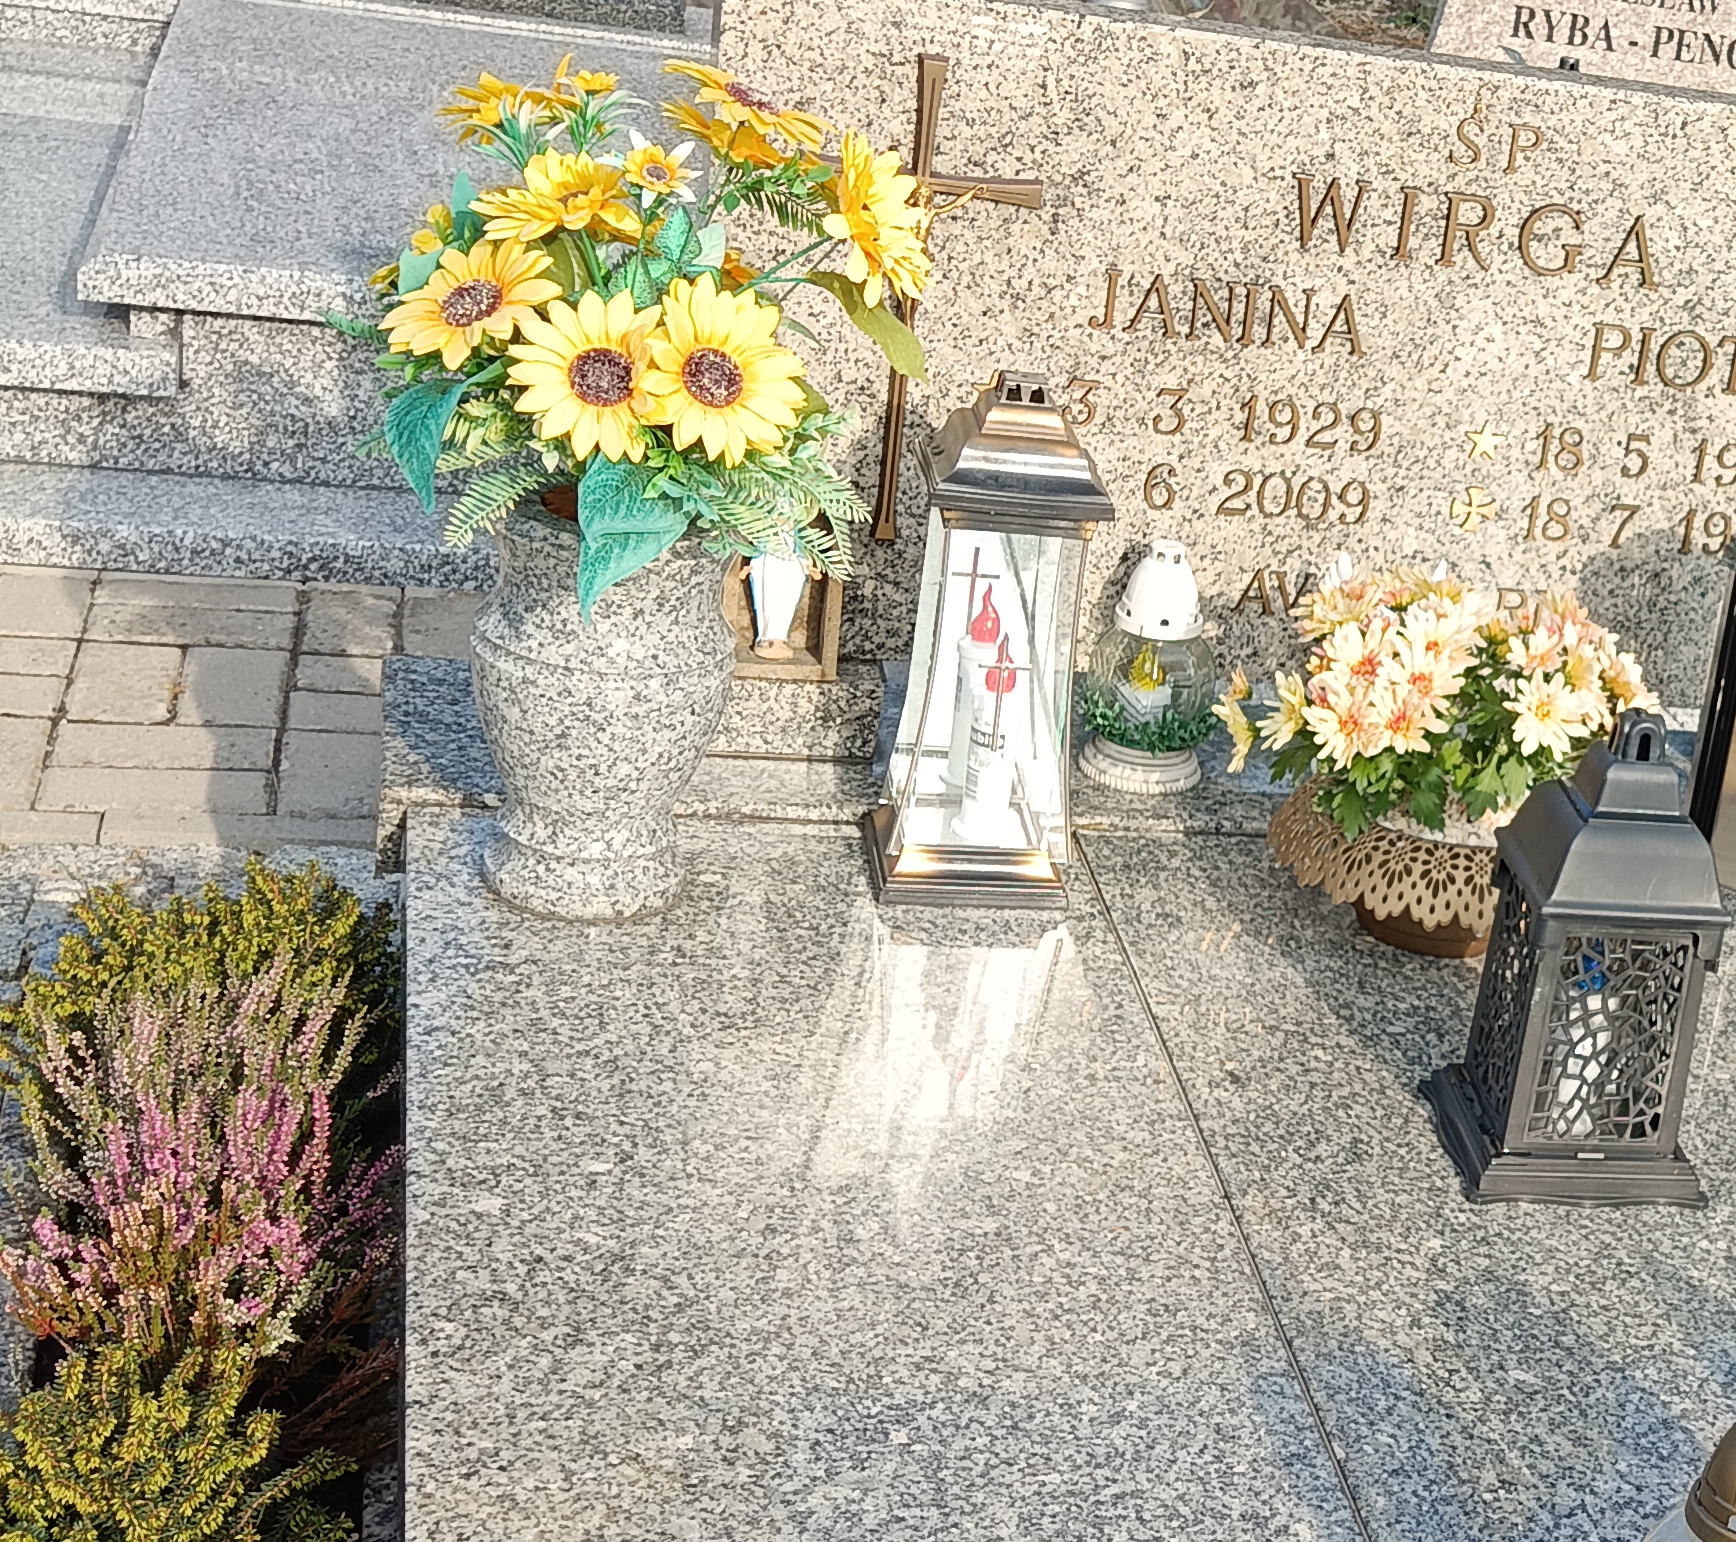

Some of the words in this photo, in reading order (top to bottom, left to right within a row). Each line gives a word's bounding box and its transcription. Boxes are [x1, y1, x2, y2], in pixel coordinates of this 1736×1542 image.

[1509, 4, 1617, 53] RYBA
[1292, 171, 1659, 291] WIRGA
[1087, 267, 1367, 357] JANINA
[1151, 387, 1190, 437] 3
[1238, 394, 1384, 453] 1929
[1535, 422, 1585, 474] 18
[1620, 432, 1653, 479] 5
[1143, 461, 1180, 512] 6
[1214, 467, 1372, 526] 2009
[1520, 495, 1572, 544] 18
[1607, 502, 1642, 550] 7
